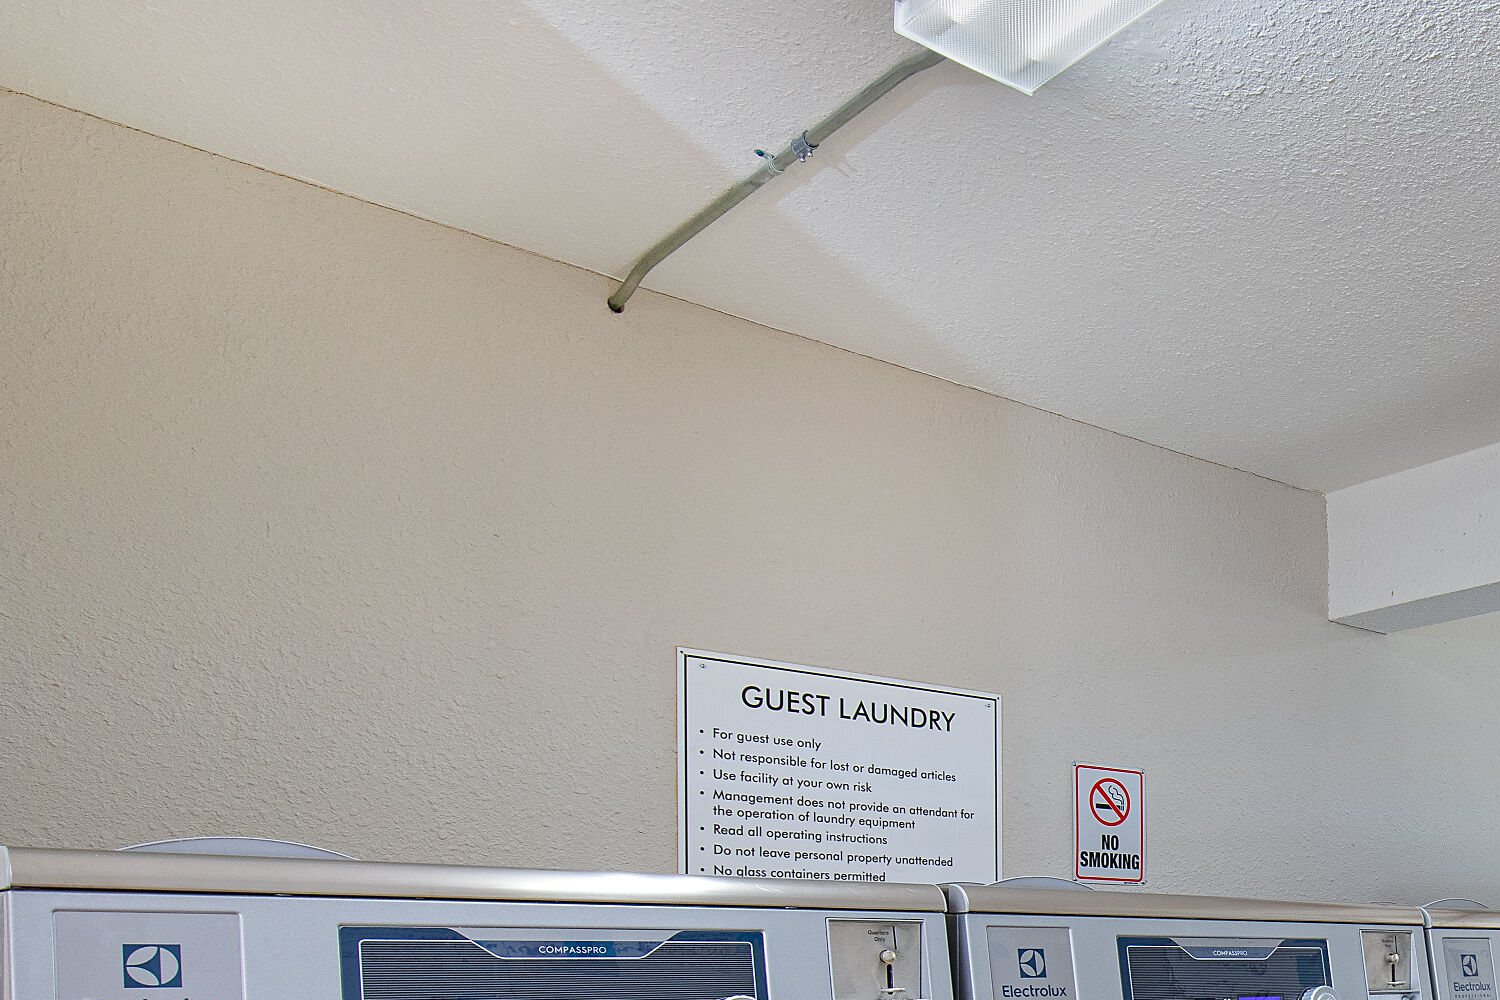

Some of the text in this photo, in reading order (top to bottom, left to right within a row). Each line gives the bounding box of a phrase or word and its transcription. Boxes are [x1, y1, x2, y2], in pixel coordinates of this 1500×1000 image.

[741, 685, 956, 732] GUEST LAUNDRY
[713, 727, 822, 752] For guest use only
[713, 748, 957, 782] Not responsible for lost or damaged articles
[713, 768, 873, 793] Use facility at your own risk
[712, 789, 975, 820] Management does not provide an attendant for
[712, 805, 916, 830] the operation of laundry equipment
[713, 823, 888, 845] Read all operating instructions
[1101, 834, 1119, 851] NO
[713, 844, 953, 867] Do not leave personal property unattended
[1079, 851, 1140, 870] SMOKING
[713, 864, 886, 882] No glass containers permitted
[538, 945, 607, 954] COMPASSPRO
[1002, 984, 1067, 997] Electrolux
[1453, 981, 1491, 991] Electrolux
